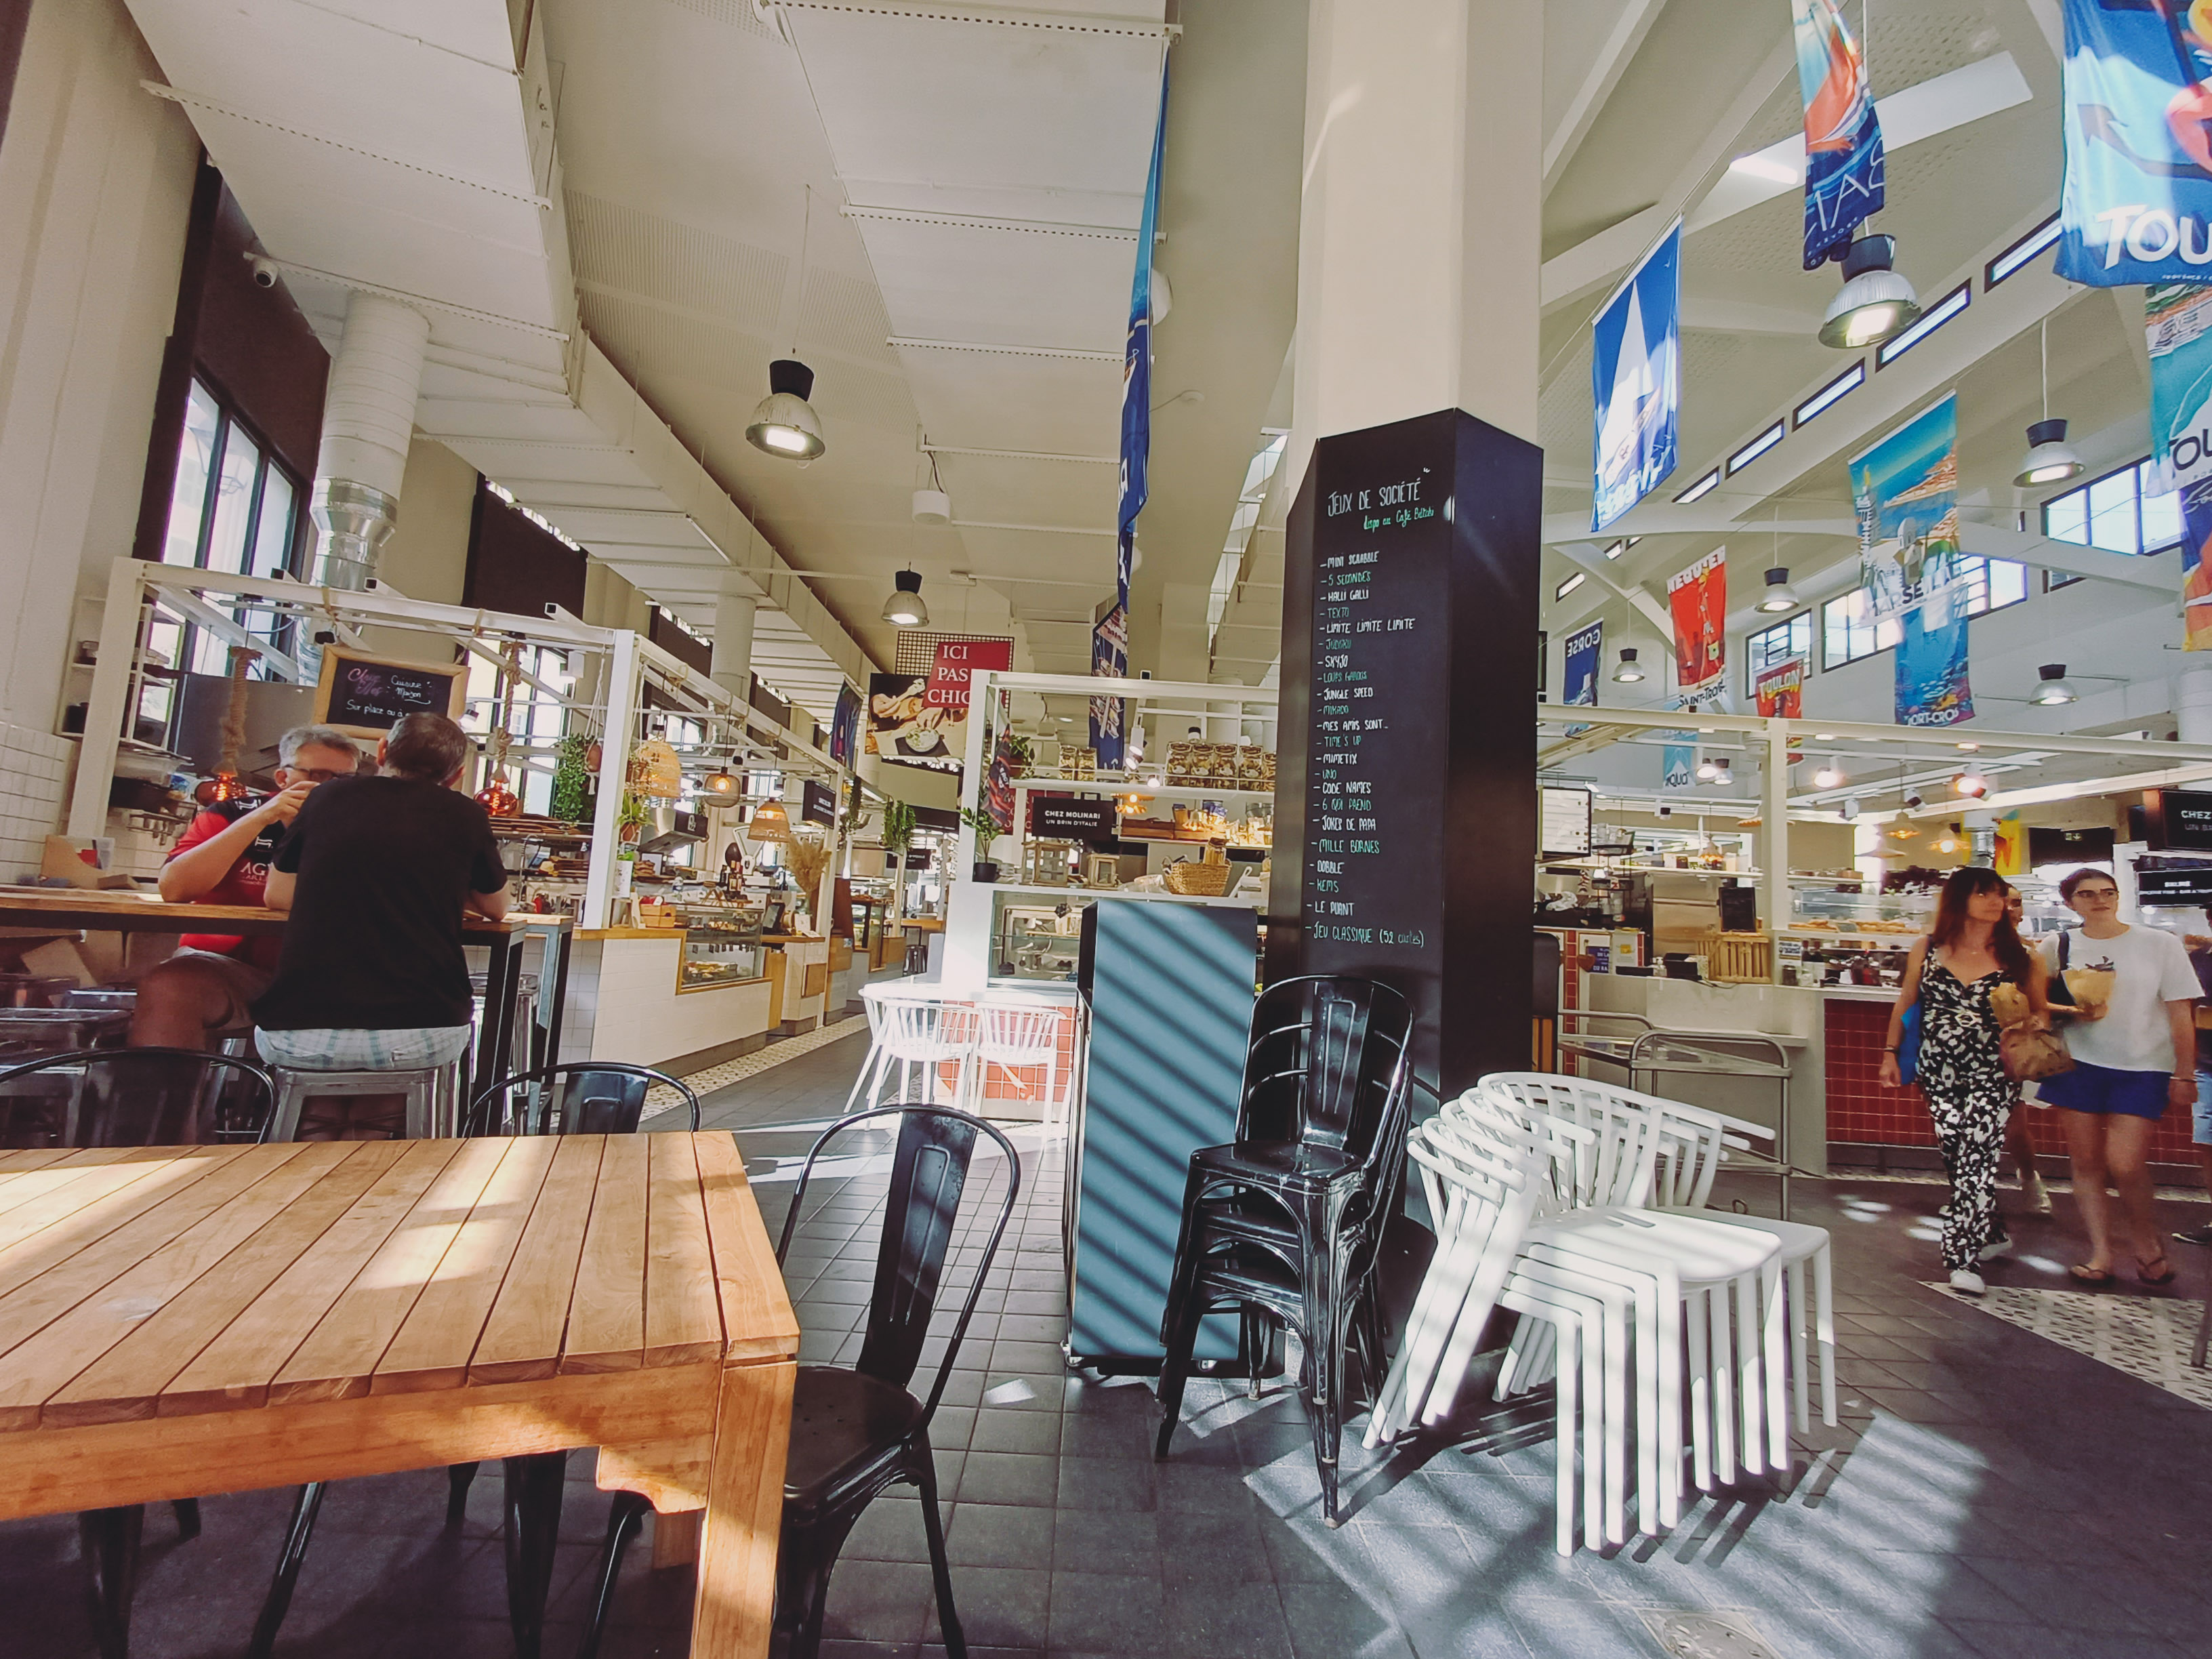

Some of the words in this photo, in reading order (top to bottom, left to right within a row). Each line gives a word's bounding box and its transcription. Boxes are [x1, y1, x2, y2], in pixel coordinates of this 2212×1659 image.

[1328, 491, 1352, 516] JEUX
[1359, 490, 1371, 510] DE
[1379, 477, 1420, 506] SOCIÉTÉ
[1396, 509, 1412, 527] Café
[1328, 556, 1344, 568] MINI
[1349, 551, 1379, 565] SCRABBLE
[1328, 574, 1333, 586] 5
[1337, 571, 1370, 585] SECONDES
[1328, 590, 1346, 602] HALLI
[1350, 590, 1368, 600] GALLI
[1328, 607, 1349, 618] TEXTO
[1327, 621, 1351, 633] LIMITE
[1357, 619, 1382, 632] LIMITE
[1387, 618, 1415, 631] LIMITE
[942, 645, 968, 659] ICI
[1325, 654, 1348, 668] SKYJO
[390, 674, 422, 689] Cuisine
[937, 667, 968, 682] PAS
[1324, 672, 1342, 682] LOUPS
[1758, 668, 1801, 702] TOULON
[1324, 688, 1349, 700] JUNGLE
[1354, 687, 1373, 697] SPEED
[346, 699, 361, 711] Sur
[364, 703, 384, 715] place
[1324, 703, 1349, 715] MIKADO
[1323, 721, 1338, 731] MES
[1343, 718, 1359, 731] AMIS
[1353, 735, 1361, 745] UP
[1324, 754, 1357, 764] MIMETIX
[1323, 769, 1336, 779] UNO
[1323, 782, 1341, 794] CODE
[1347, 781, 1371, 794] NAMES
[1323, 798, 1327, 810] 6
[1332, 798, 1343, 811] QUI
[1066, 811, 1101, 819] MOLINARI
[2181, 810, 2211, 819] CHEZ
[1322, 815, 1342, 831] JOKES
[1347, 819, 1355, 831] DE
[1359, 818, 1376, 831] PAPA
[1319, 839, 1344, 853] MILLE
[1351, 840, 1379, 853] BORNES
[1317, 860, 1345, 874] DOBBLE
[1317, 879, 1338, 893] KEMS
[1315, 901, 1325, 913] LE
[1314, 921, 1328, 939] JEU
[1332, 926, 1372, 944] CLASSIQUE
[1380, 929, 1393, 944] (52
